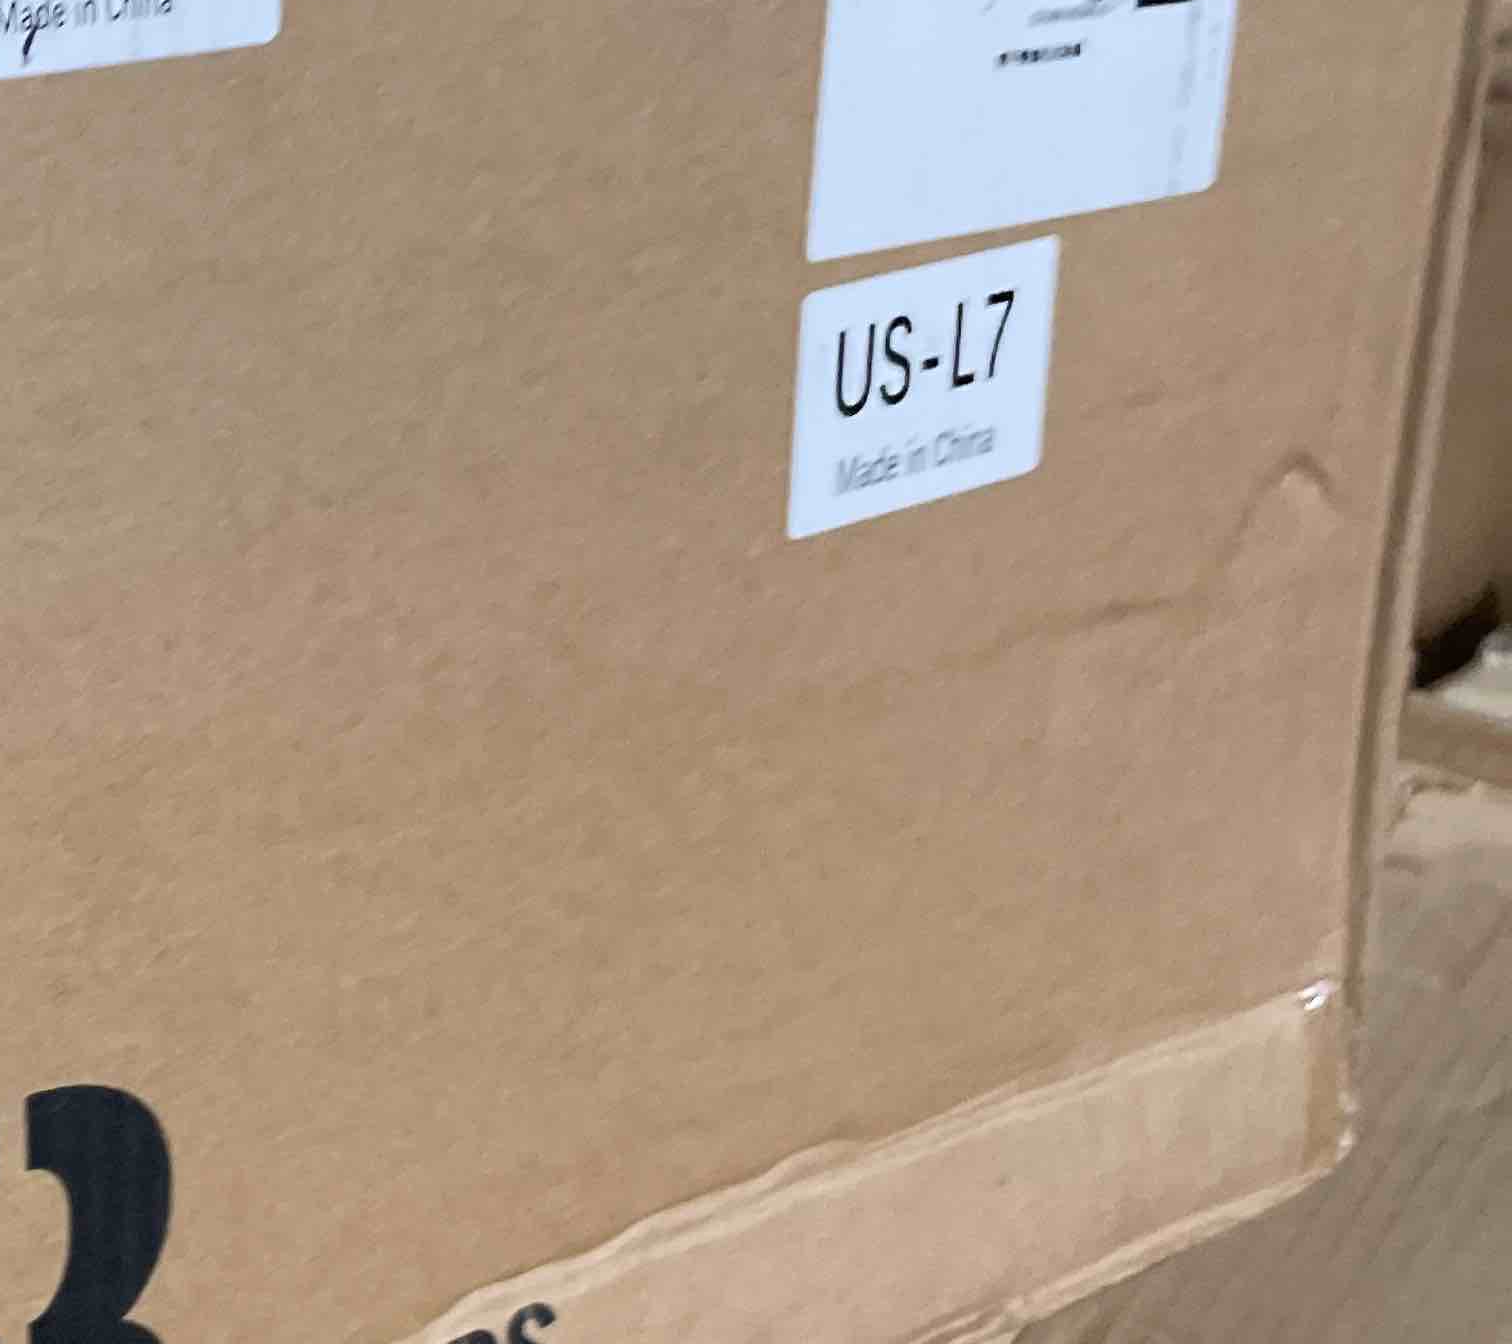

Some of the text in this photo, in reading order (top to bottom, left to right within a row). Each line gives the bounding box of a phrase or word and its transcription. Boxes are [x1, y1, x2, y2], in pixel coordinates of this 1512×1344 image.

[835, 288, 1016, 418] US-L7
[833, 425, 998, 498] Made in China
